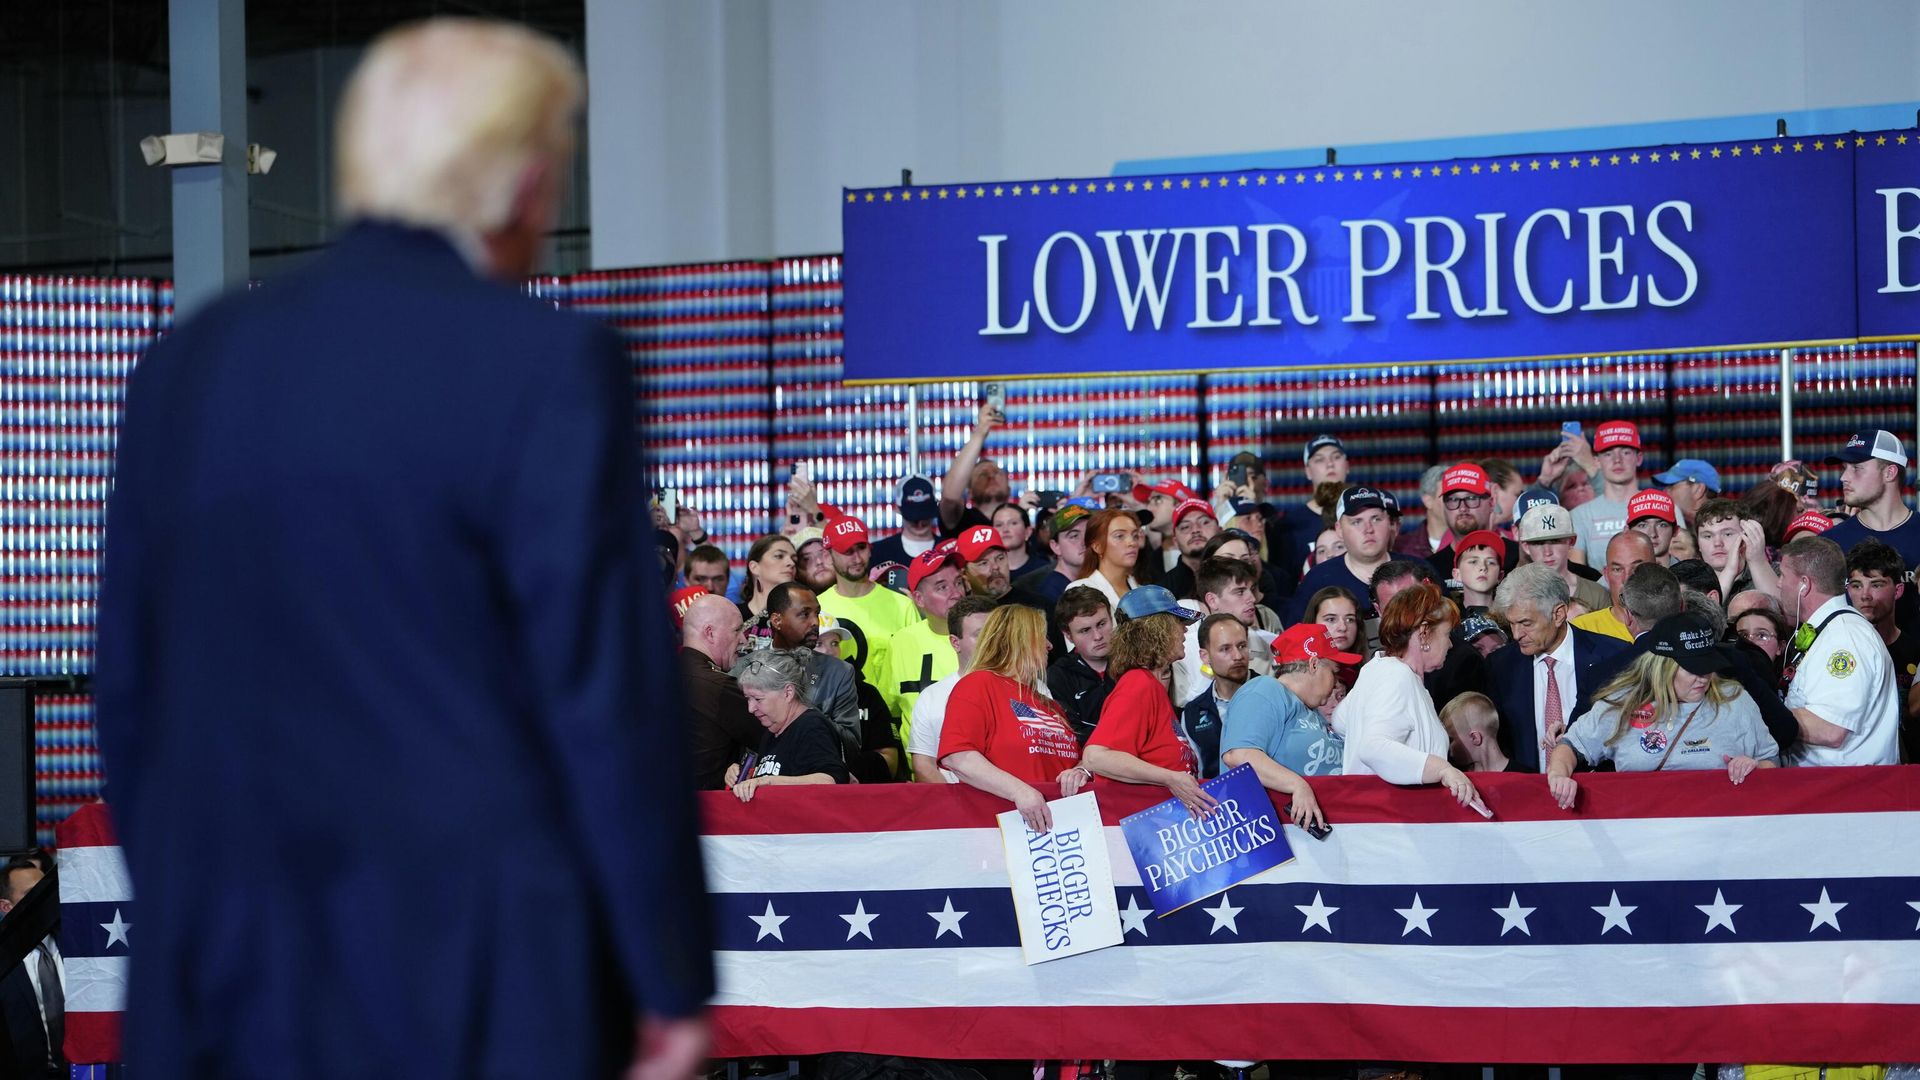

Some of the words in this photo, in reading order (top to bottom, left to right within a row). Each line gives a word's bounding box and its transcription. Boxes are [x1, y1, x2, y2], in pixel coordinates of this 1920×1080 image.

[977, 223, 1320, 335] LOWER
[1340, 199, 1699, 323] PRICES
[1631, 495, 1646, 505] MAKE
[1646, 493, 1672, 505] AMERICA
[1633, 503, 1651, 513] GREAT
[1651, 502, 1670, 512] AGAIN
[835, 521, 863, 535] USA
[972, 528, 992, 543] 47
[1680, 631, 1699, 641] Make
[1684, 640, 1705, 650] Great
[1029, 746, 1056, 755] DONALD
[1055, 742, 1071, 750] WITH
[1156, 798, 1247, 855] BIGGER
[1144, 814, 1276, 893] PAYCHECKS
[1055, 827, 1094, 923] BIGGER
[1022, 820, 1072, 951] AYCHECKS
